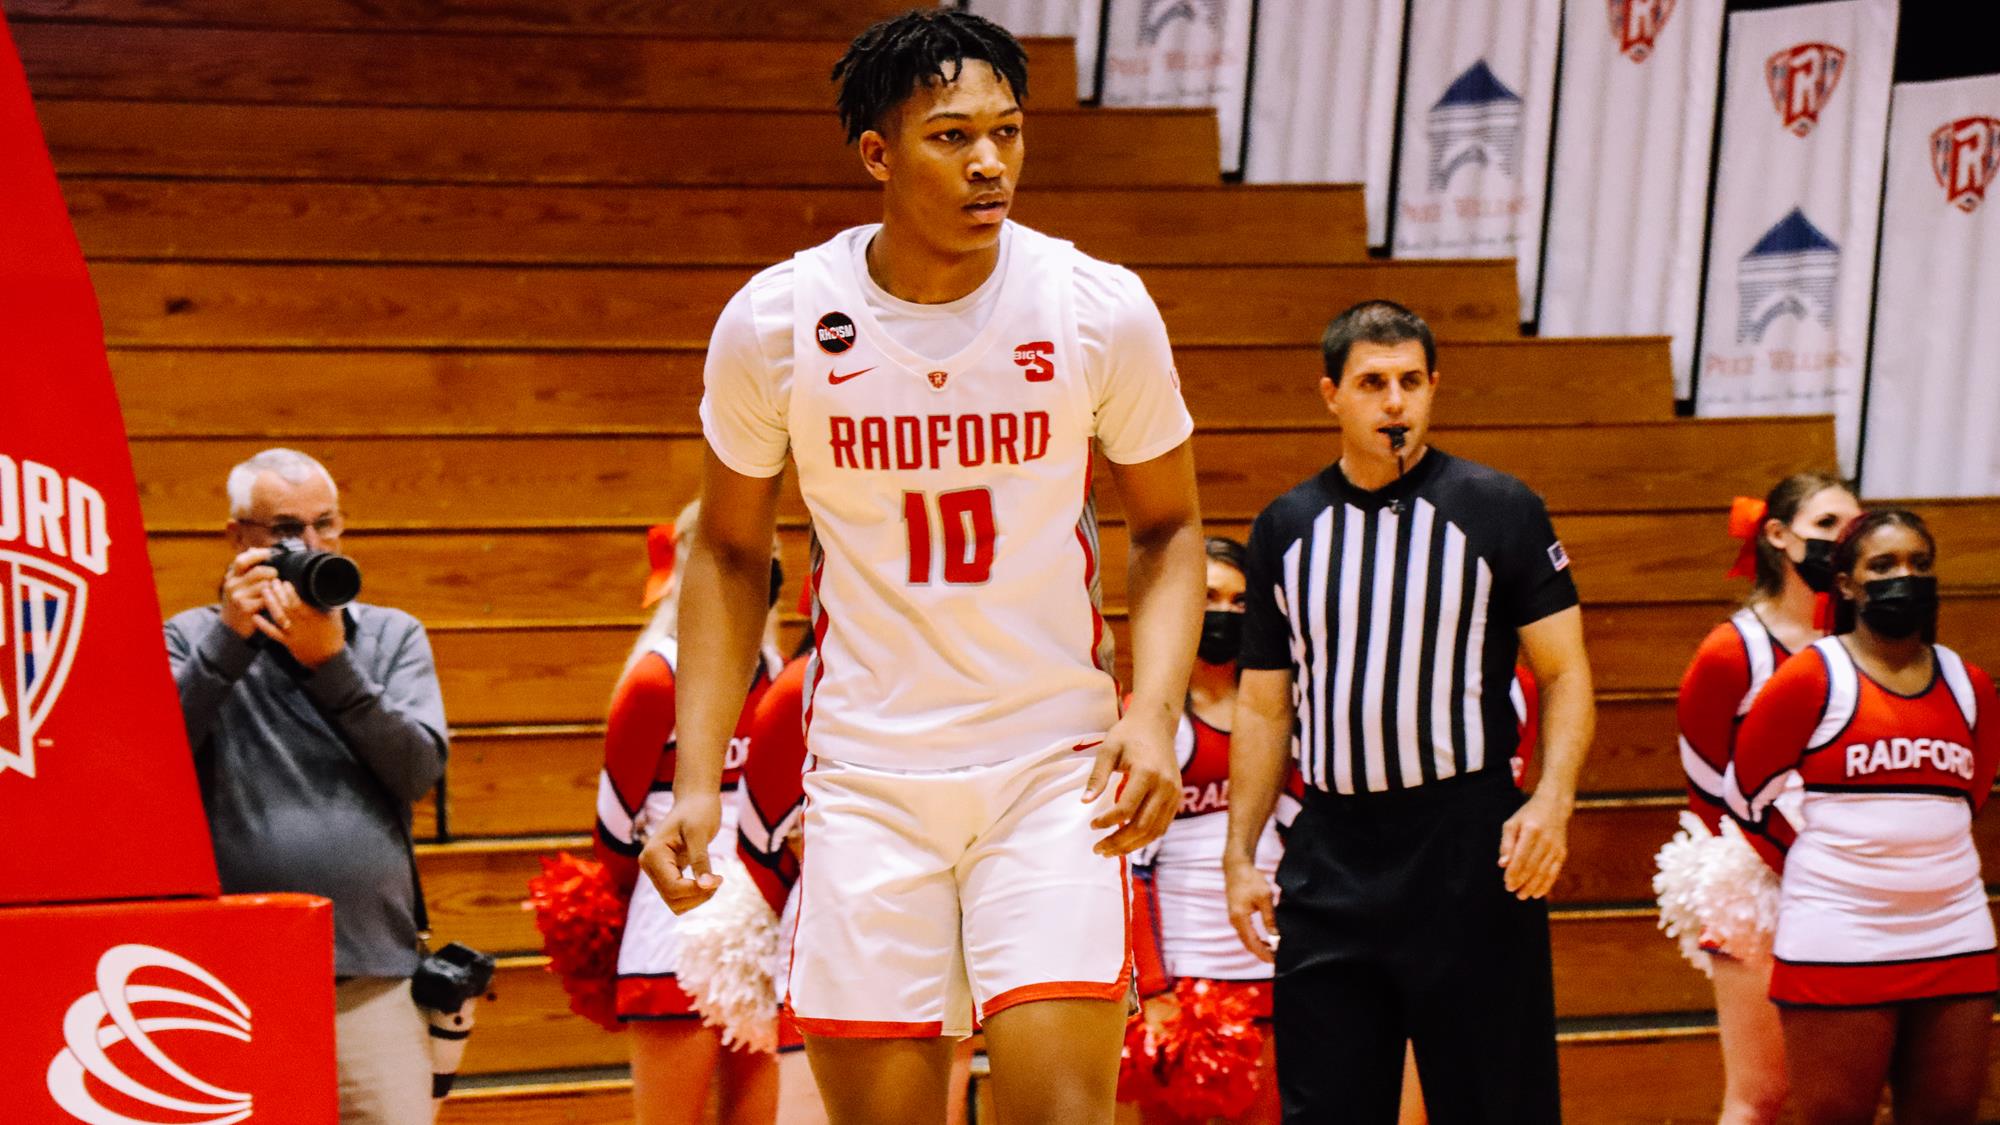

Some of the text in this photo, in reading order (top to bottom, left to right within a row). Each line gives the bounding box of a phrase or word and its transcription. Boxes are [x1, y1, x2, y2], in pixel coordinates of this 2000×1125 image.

[1013, 350, 1036, 360] BIG
[829, 410, 1052, 471] RADFORD
[901, 485, 997, 587] 10
[1846, 738, 1975, 780] RADFORD
